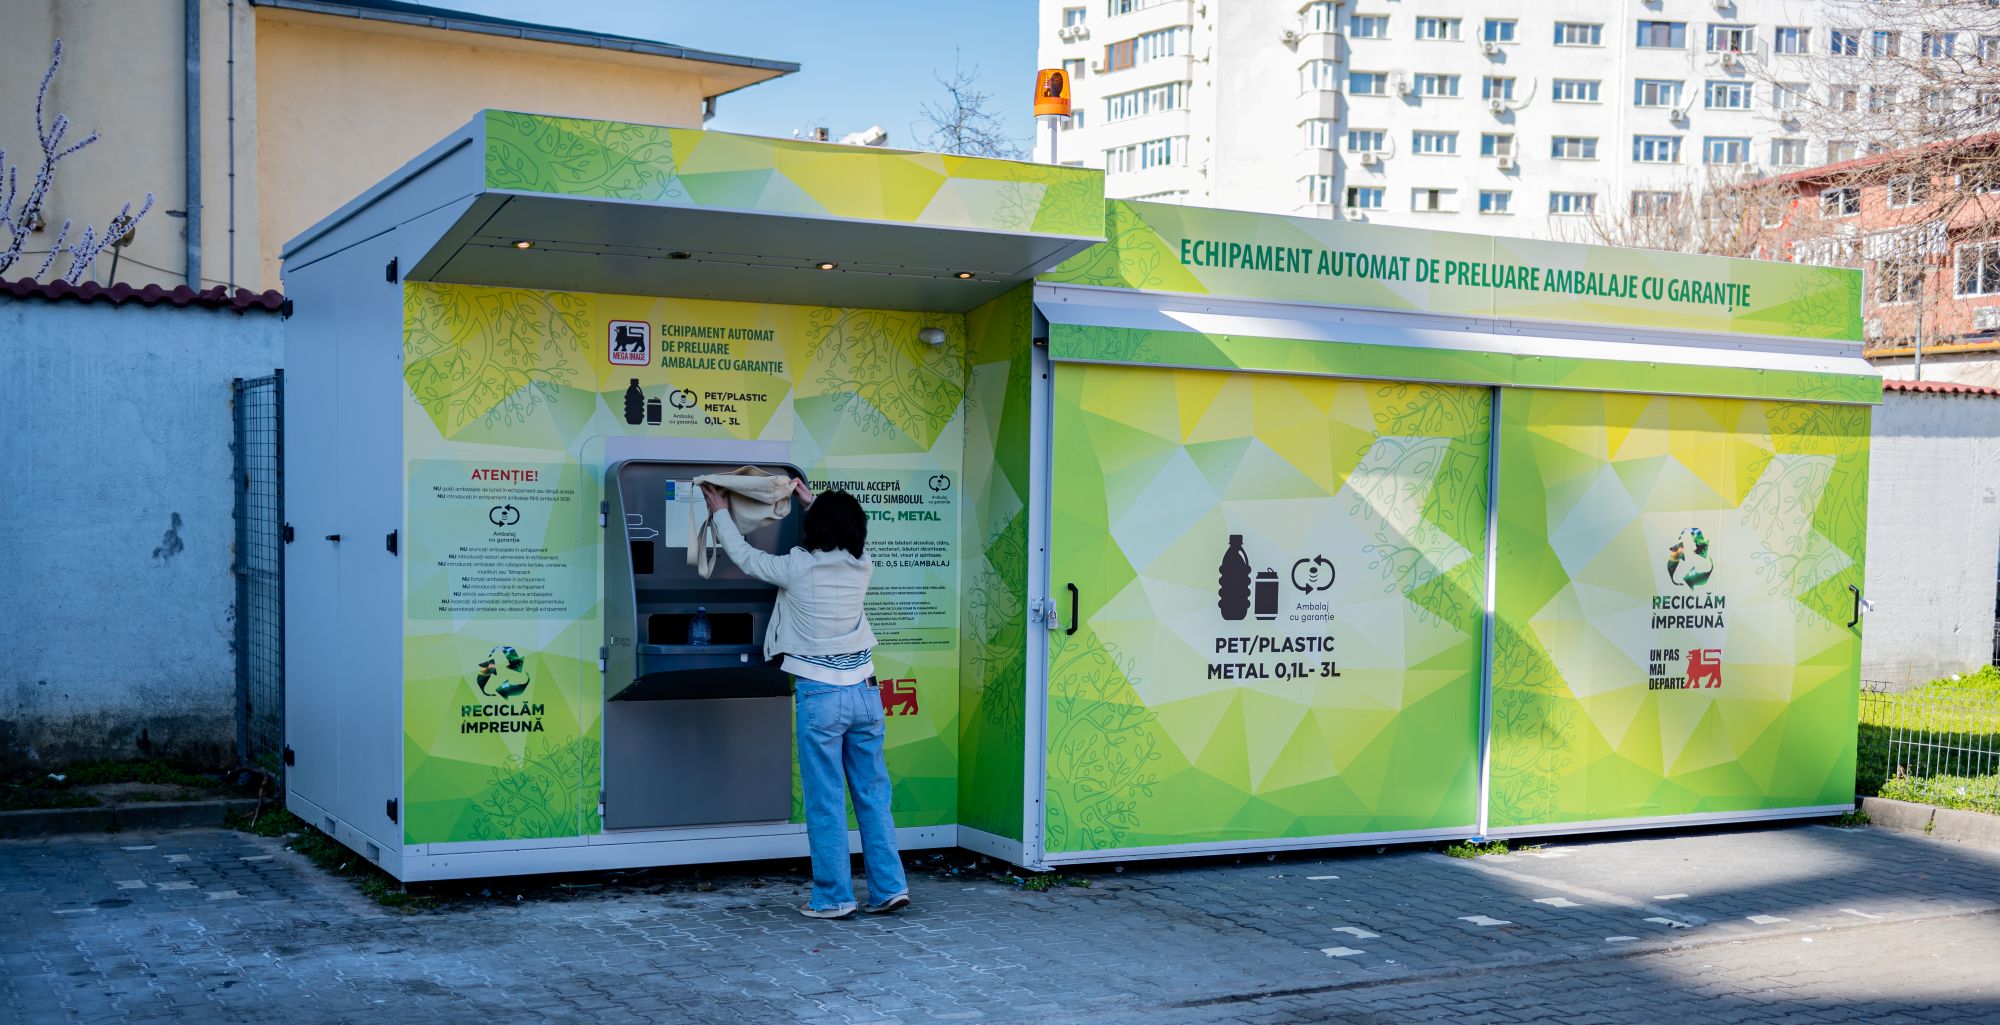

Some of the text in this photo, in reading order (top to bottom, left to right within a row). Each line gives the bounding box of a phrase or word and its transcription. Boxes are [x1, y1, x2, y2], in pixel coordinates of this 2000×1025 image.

[1180, 239, 1750, 312] ECHIPAMENT AUTOMAT DE PRELUARE AMBALAJE CU GARANȚIE
[661, 324, 774, 342] ECHIPAMENT AUTOMAT
[661, 341, 730, 355] DE PRELUARE
[613, 352, 645, 361] MEGA IMAGE
[660, 357, 783, 375] AMBALAJE CU GARANȚIE
[704, 391, 768, 402] PET/PLASTIC
[704, 403, 737, 413] METAL
[728, 416, 741, 426] 3L
[471, 469, 539, 485] ATENȚIE!
[866, 480, 901, 491] ACCEPTĂ
[871, 494, 882, 503] CU
[883, 494, 924, 504] SIMBOLUL
[897, 510, 942, 522] METAL
[899, 560, 950, 568] LEI/AMBALAJ
[1652, 592, 1726, 609] RECICLĂM
[1296, 602, 1329, 612] Ambalaj
[1301, 612, 1335, 622] garanție
[1215, 635, 1335, 655] PET/PLASTIC
[1649, 649, 1680, 661] UN PAS
[1207, 663, 1269, 680] METAL
[1320, 661, 1341, 677] 3L
[1649, 663, 1666, 676] MAI
[1649, 677, 1685, 690] DEPARTE
[461, 701, 545, 717] RECICLĂM
